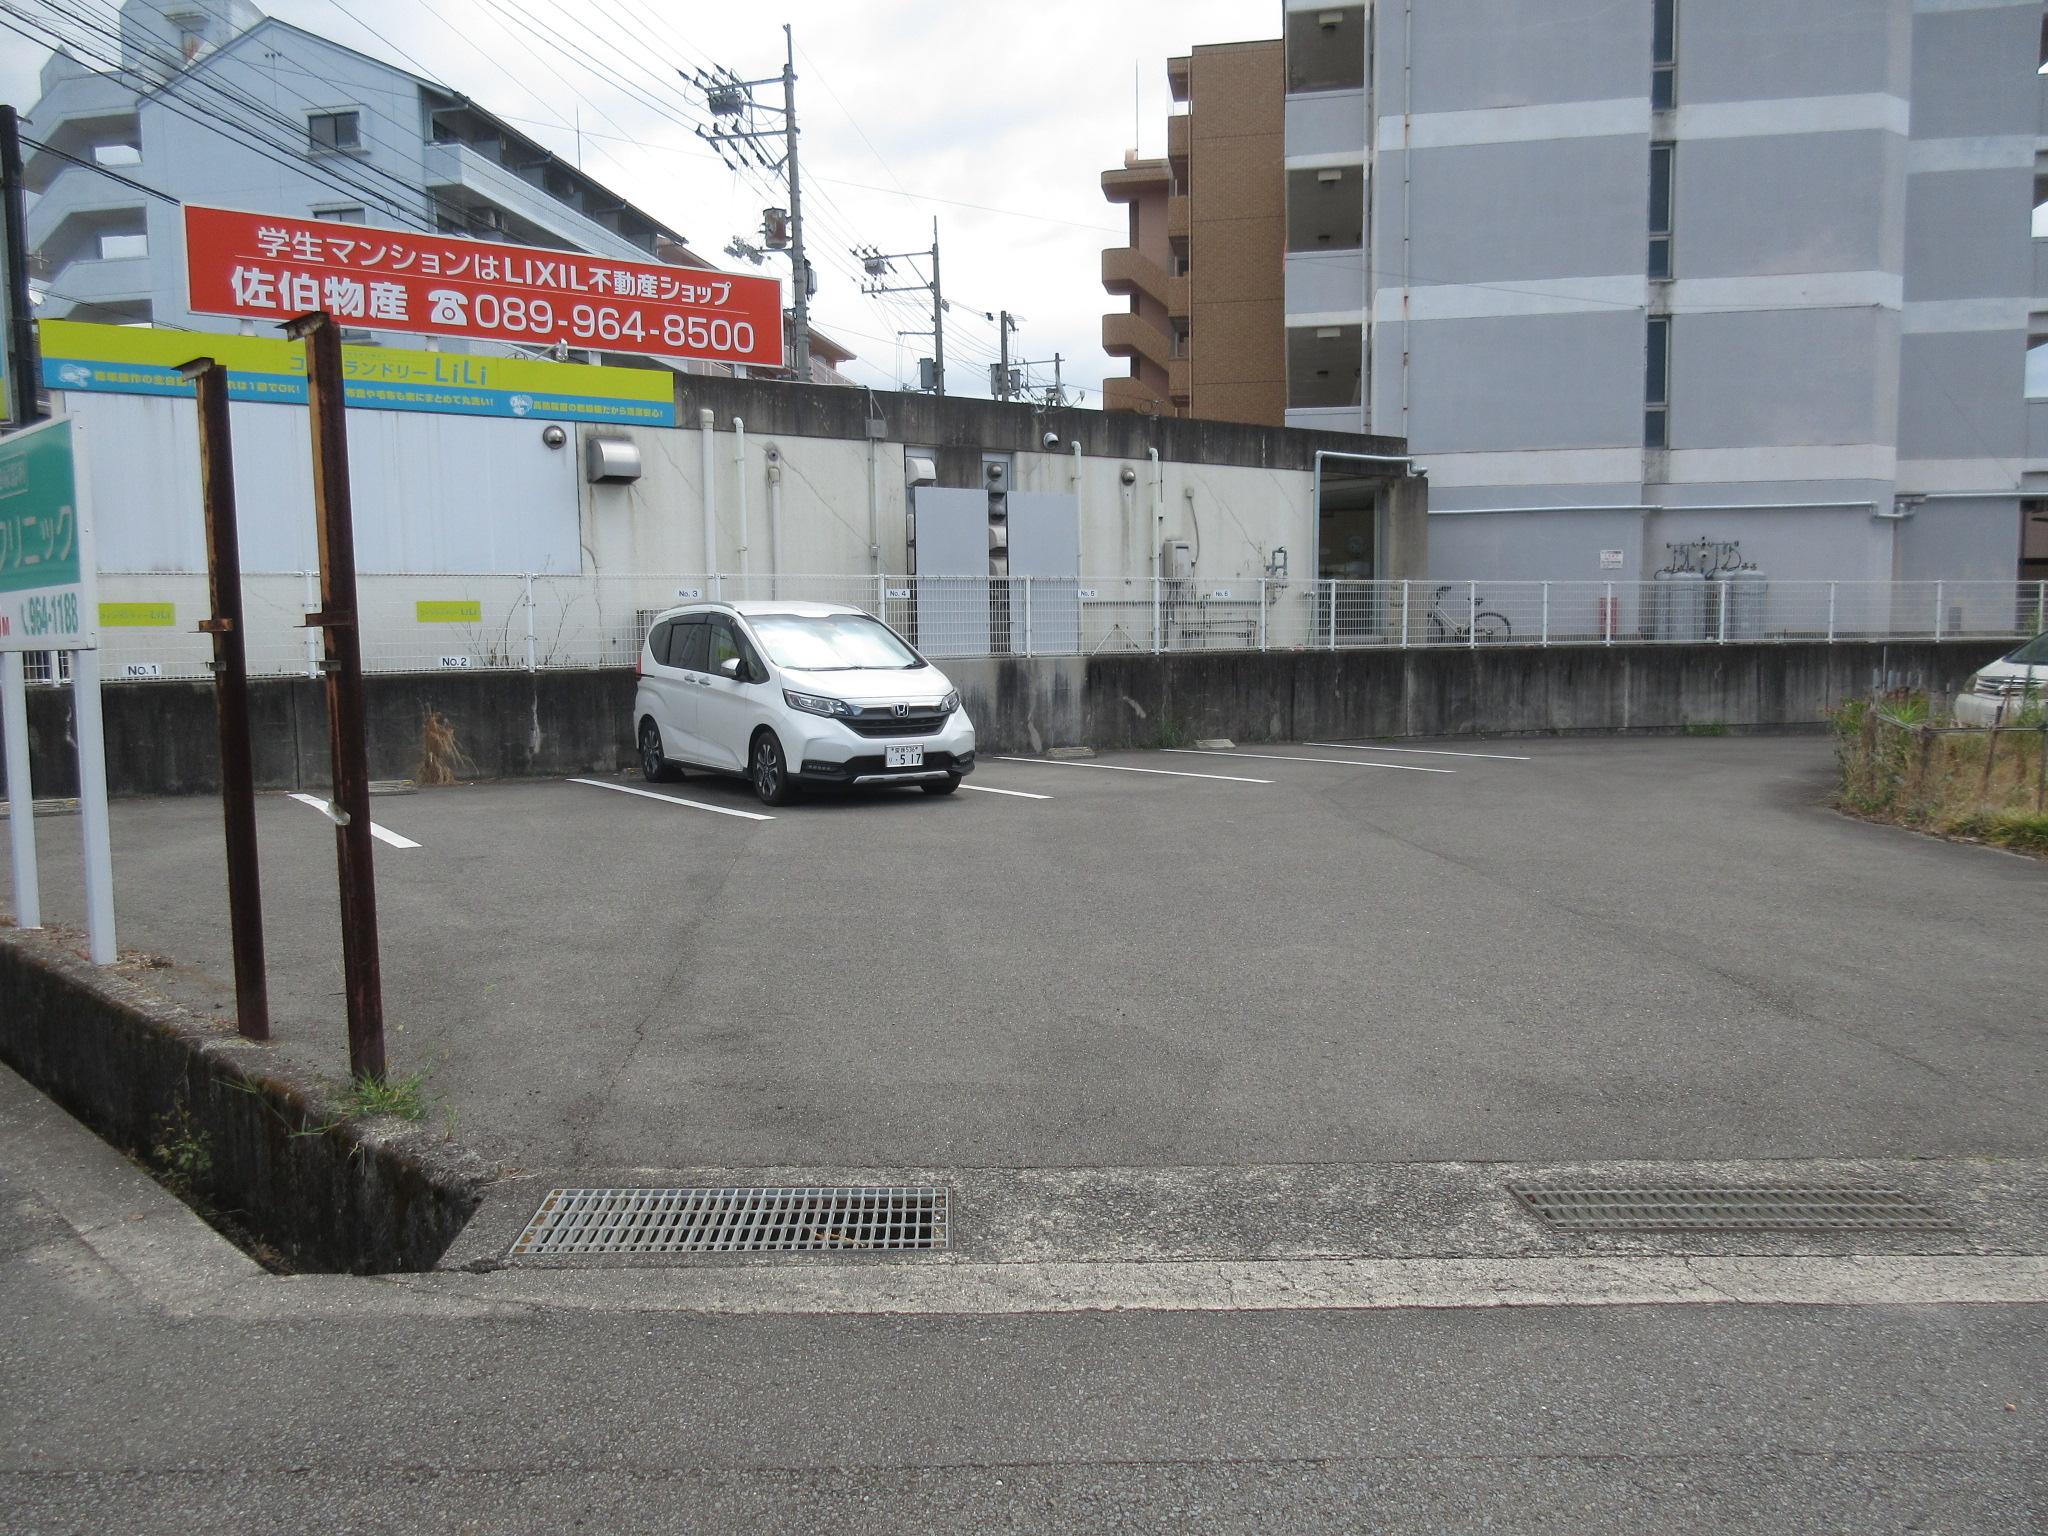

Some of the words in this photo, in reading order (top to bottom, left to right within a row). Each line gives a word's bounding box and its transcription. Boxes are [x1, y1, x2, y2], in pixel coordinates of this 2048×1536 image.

[258, 226, 732, 305] 学生マンションはLIXIL不動産ショップ
[231, 265, 409, 322] 佐伯物産
[475, 293, 755, 353] 089-964-8500
[290, 356, 428, 379] コランドリー
[435, 357, 487, 385] LiLi
